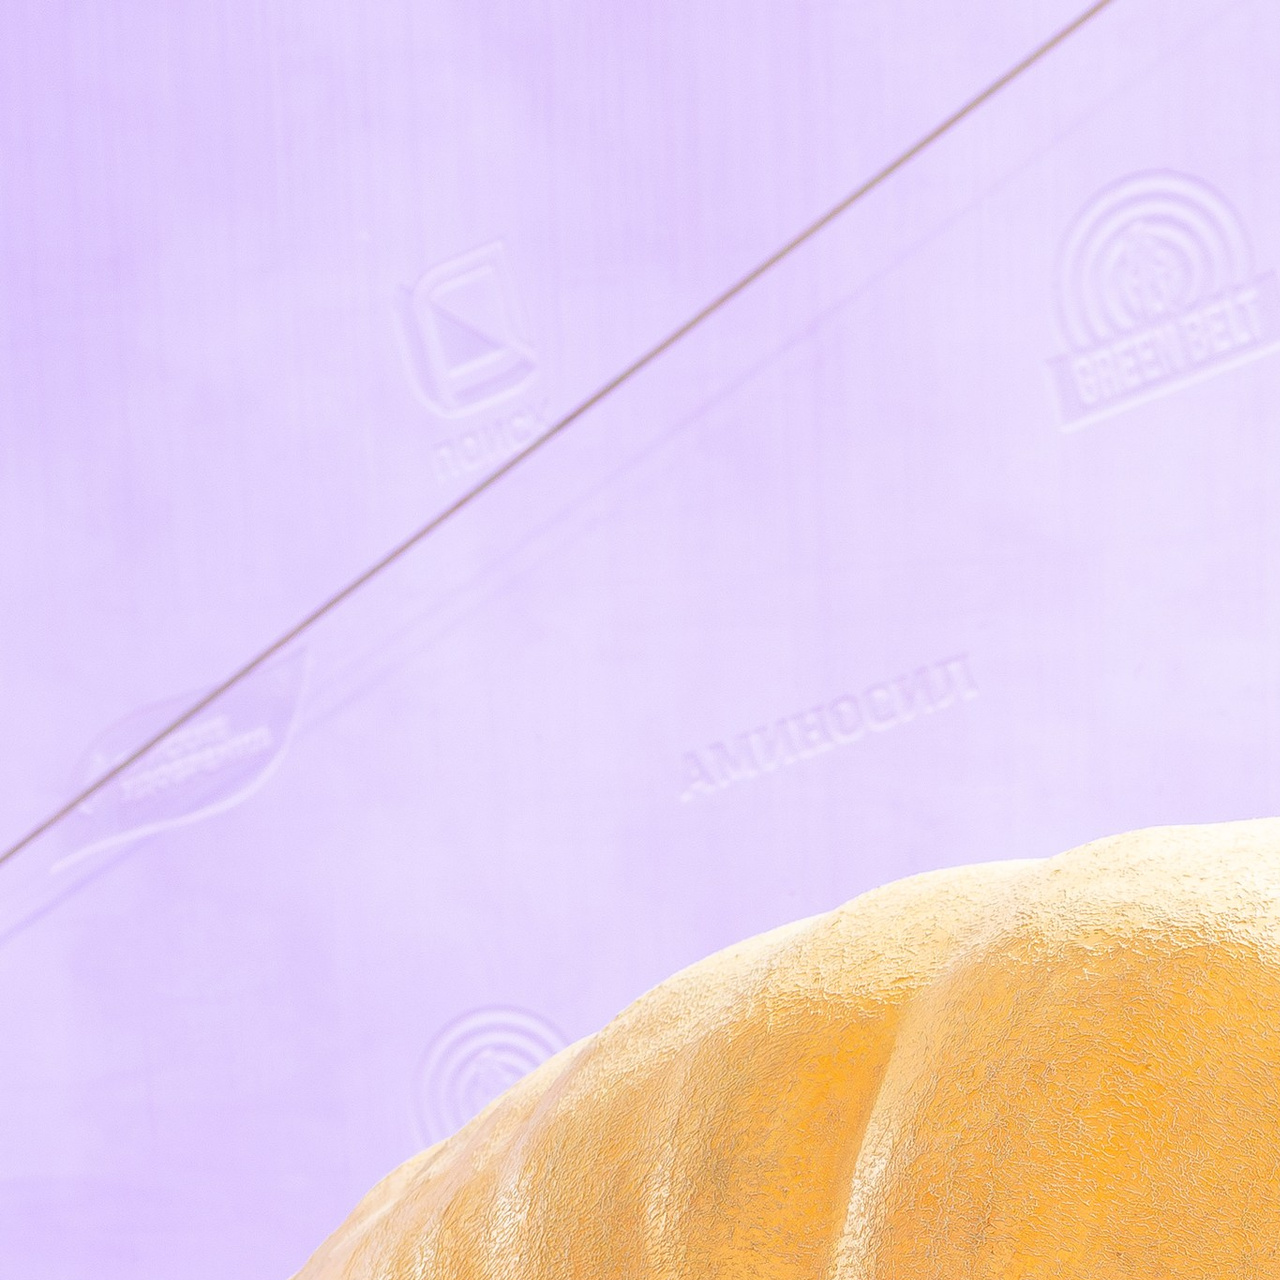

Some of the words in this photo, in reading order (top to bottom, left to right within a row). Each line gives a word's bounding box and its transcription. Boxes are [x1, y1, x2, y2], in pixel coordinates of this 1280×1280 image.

[1070, 321, 1185, 405] GREEN
[1180, 288, 1262, 361] BELT
[680, 652, 980, 802] АМИНОСИЛ
